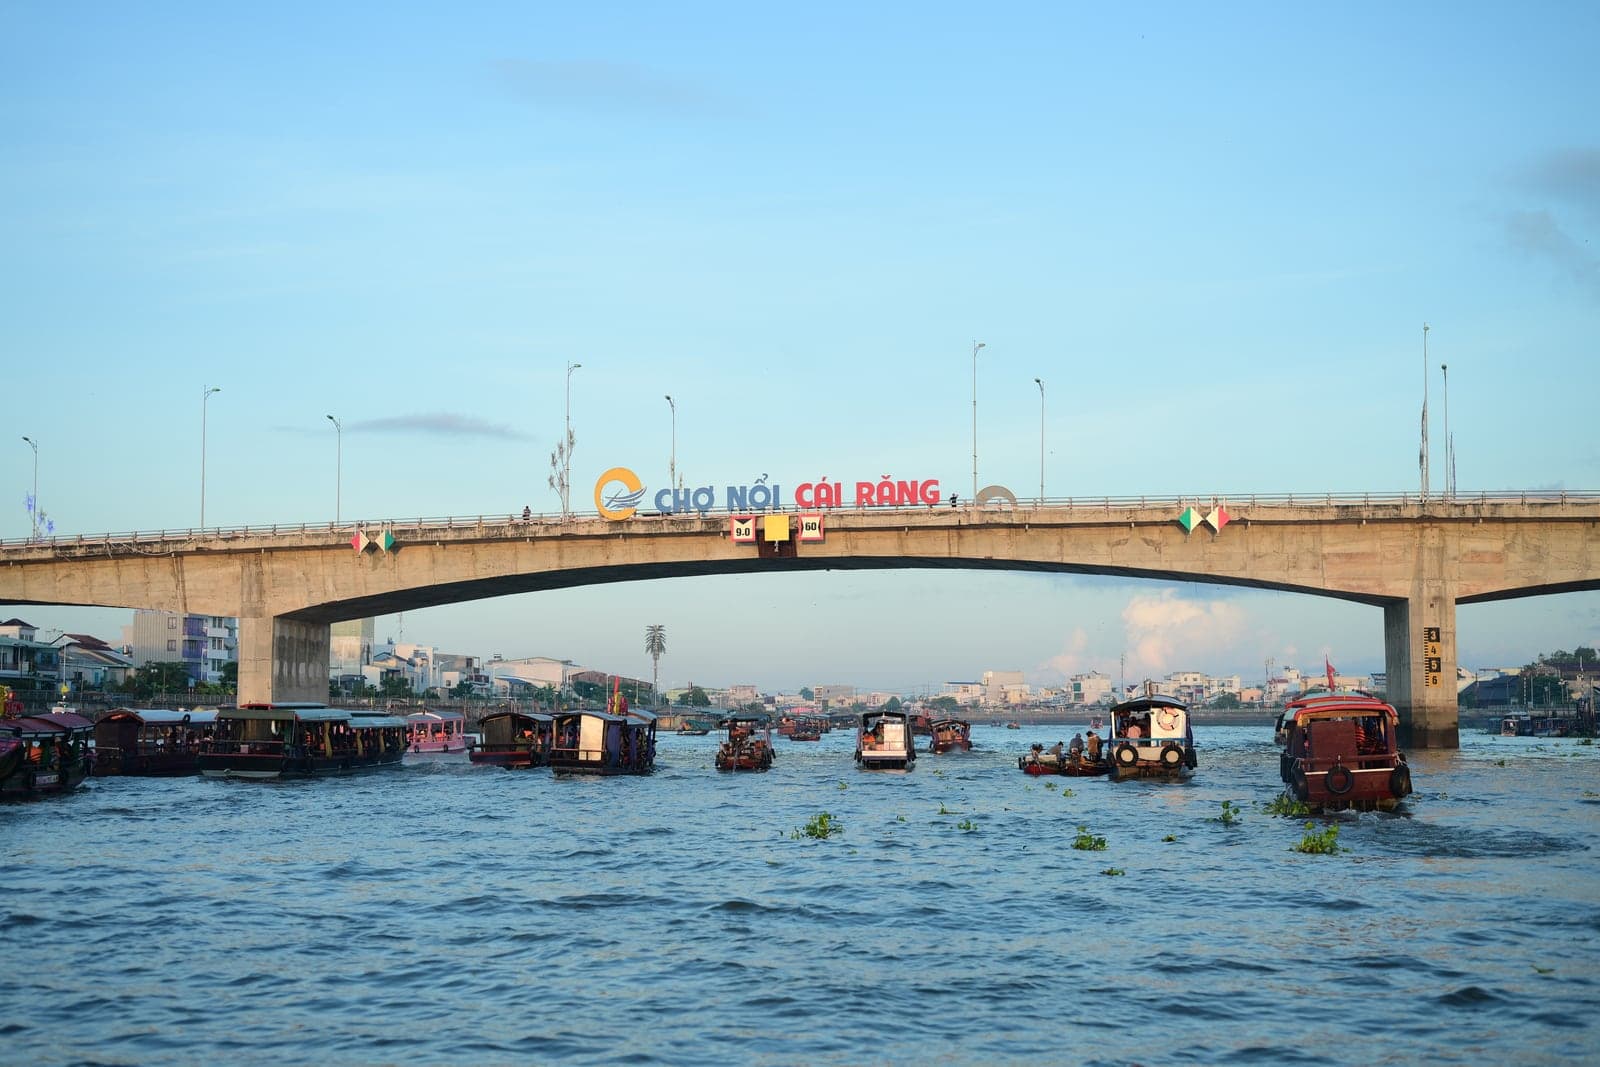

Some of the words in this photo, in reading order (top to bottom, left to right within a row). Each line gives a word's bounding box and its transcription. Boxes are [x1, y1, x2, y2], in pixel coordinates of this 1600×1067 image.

[654, 485, 715, 517] CHỢ
[727, 473, 780, 511] NỔI
[795, 476, 842, 508] CÁI
[856, 474, 940, 505] RĂNG
[805, 522, 817, 531] 60
[736, 527, 751, 537] 9.0
